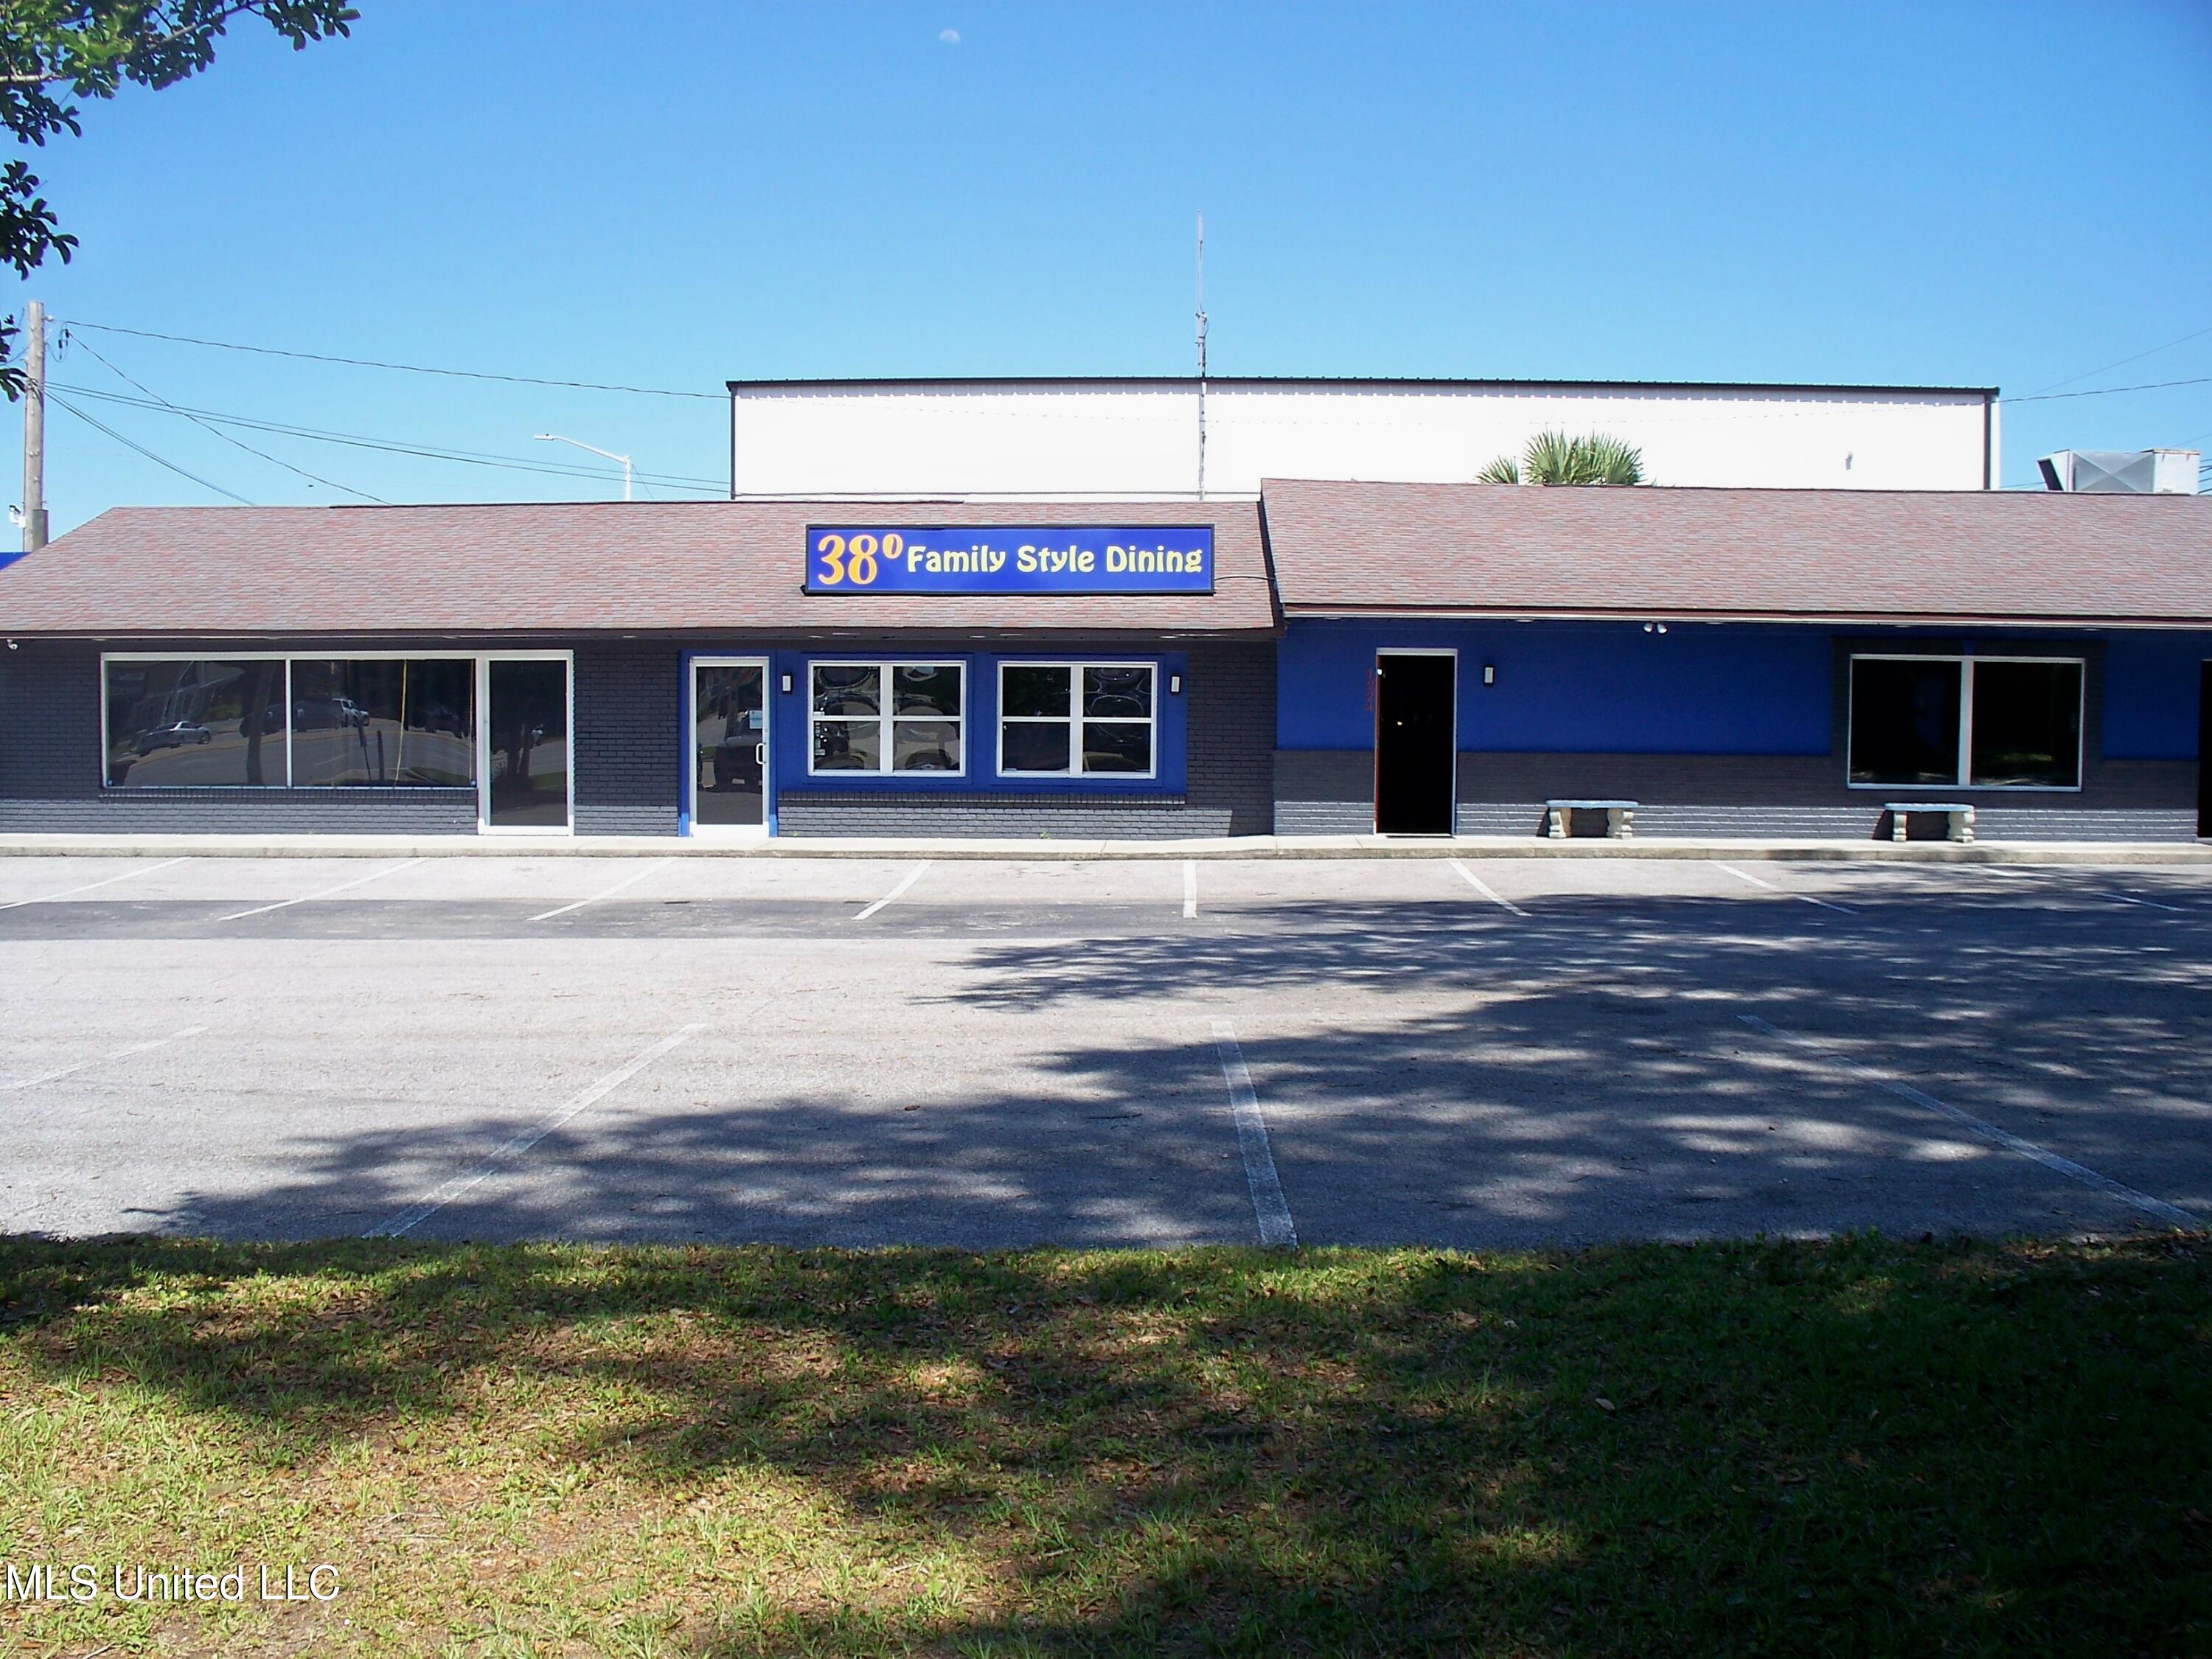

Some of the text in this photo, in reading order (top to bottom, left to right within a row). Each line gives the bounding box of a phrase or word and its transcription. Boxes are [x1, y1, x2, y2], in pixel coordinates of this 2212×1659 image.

[907, 545, 1006, 573] Family
[1017, 545, 1095, 573] Style
[1106, 545, 1203, 573] Dining
